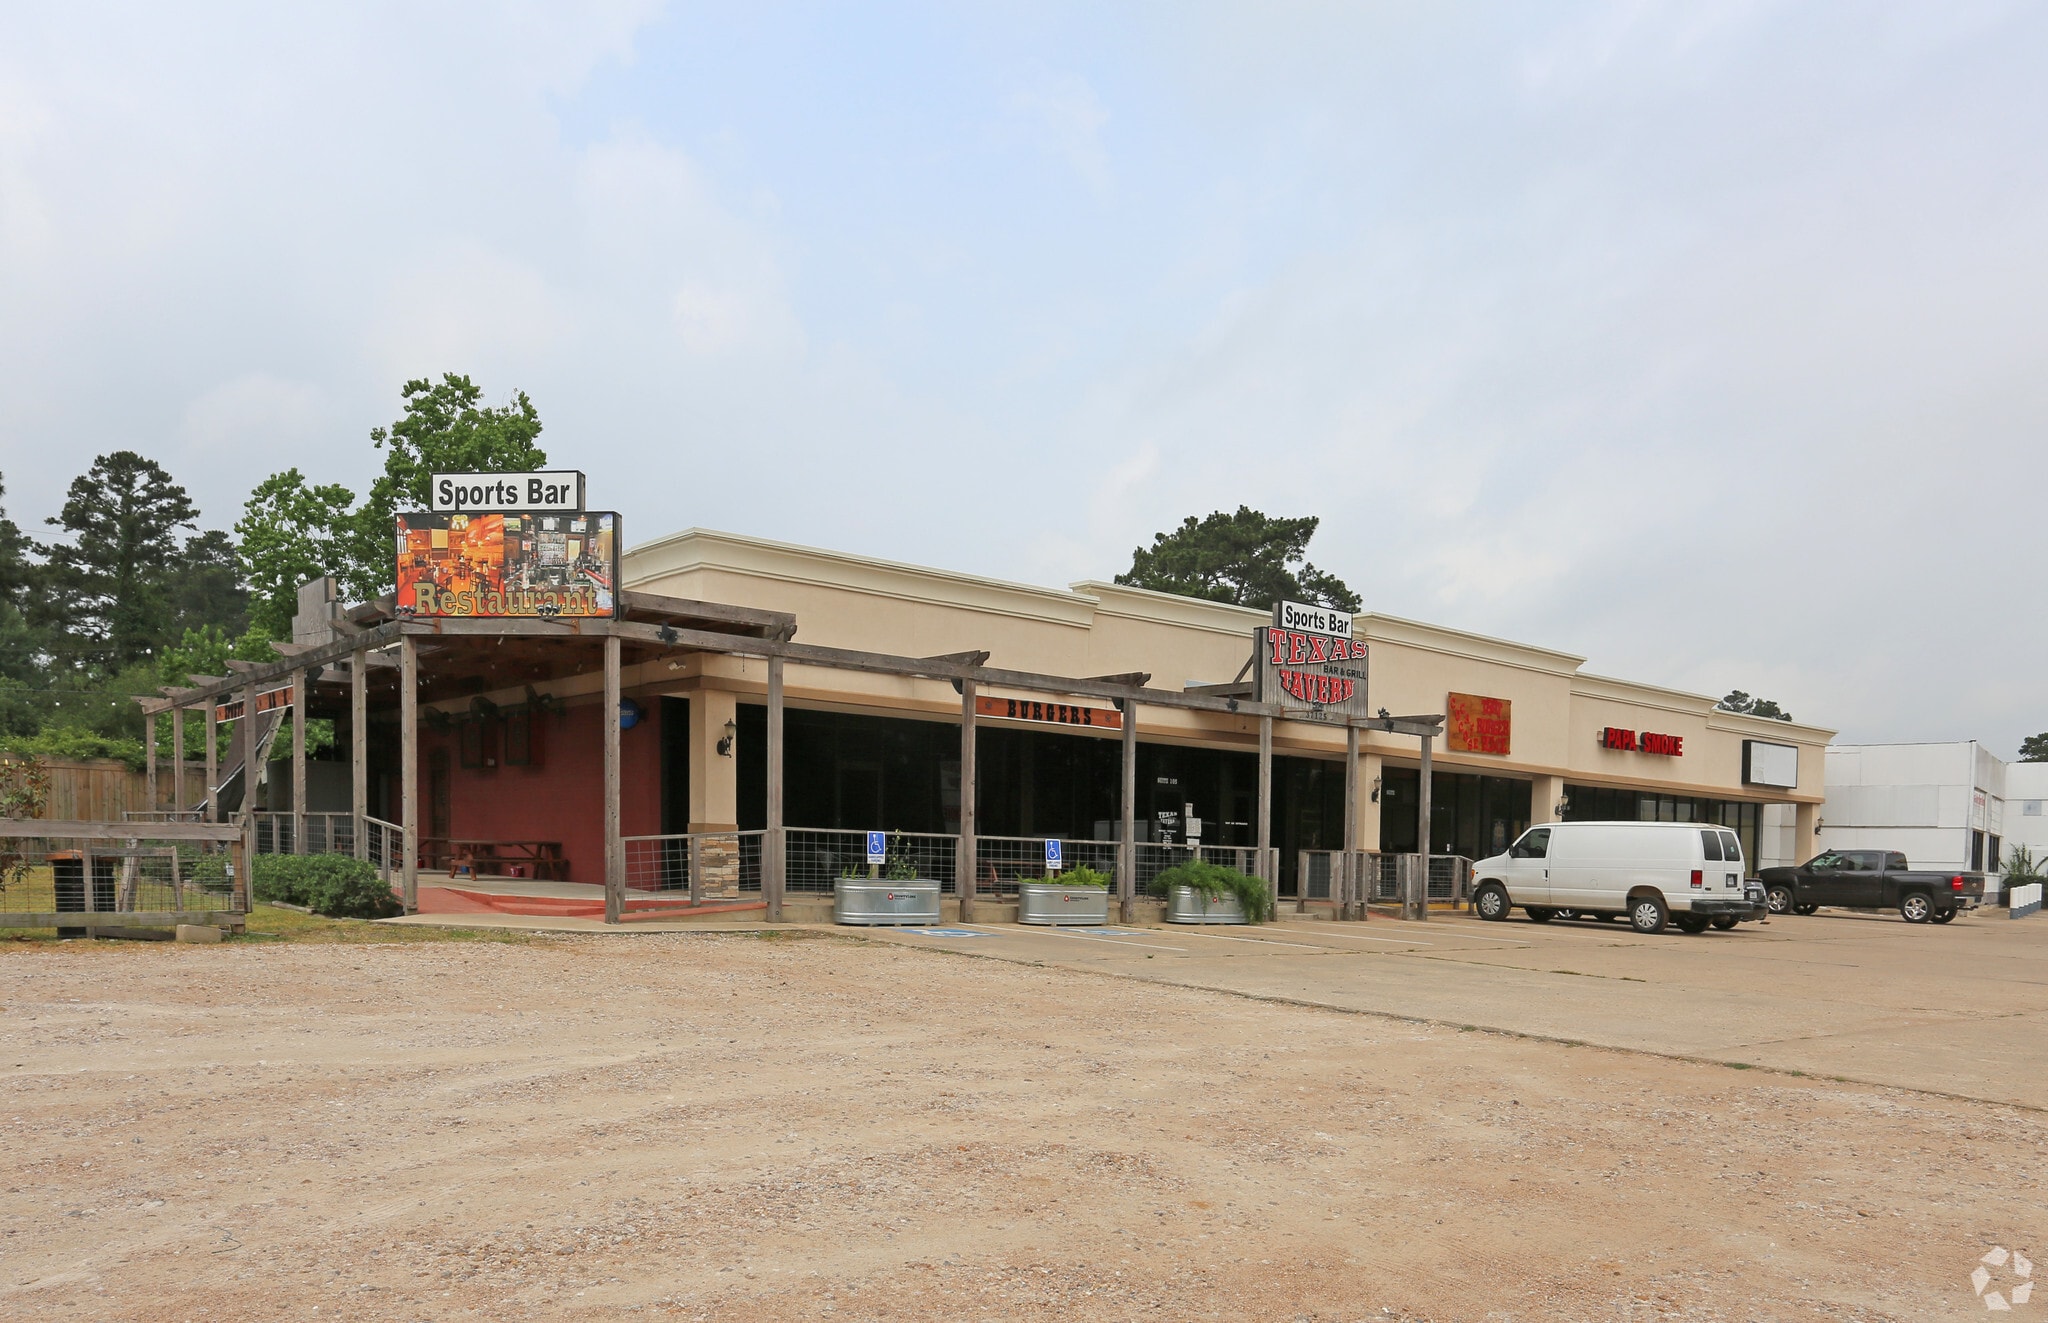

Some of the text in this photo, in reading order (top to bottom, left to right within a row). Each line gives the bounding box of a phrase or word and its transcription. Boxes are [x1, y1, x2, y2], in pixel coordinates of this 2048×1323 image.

[438, 478, 570, 511] Sports Bar
[412, 581, 598, 615] Restaurant
[1285, 605, 1349, 634] Sports Bar
[1268, 627, 1367, 665] TEXAS
[1279, 669, 1355, 704] TAVERN
[1323, 665, 1339, 676] BAR
[1346, 669, 1367, 680] GRILL
[1007, 699, 1092, 725] BURGERS
[1605, 727, 1683, 756] PAPA SMOKE
